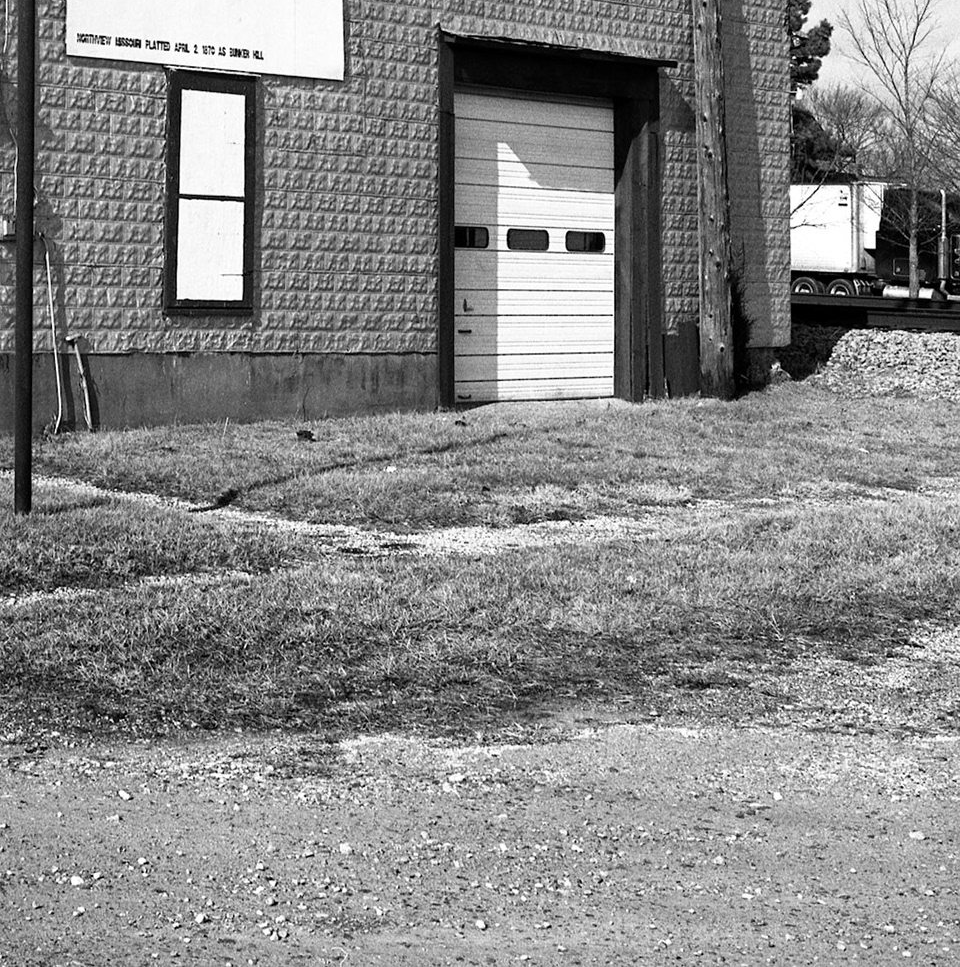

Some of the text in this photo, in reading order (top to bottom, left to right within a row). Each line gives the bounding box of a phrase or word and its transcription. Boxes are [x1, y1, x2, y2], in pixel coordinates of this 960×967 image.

[145, 39, 171, 52] PLATTED
[174, 42, 190, 54] APRIL
[202, 45, 216, 56] 1870
[218, 46, 227, 57] AS
[229, 47, 250, 59] BUNKER
[252, 50, 265, 61] HILL
